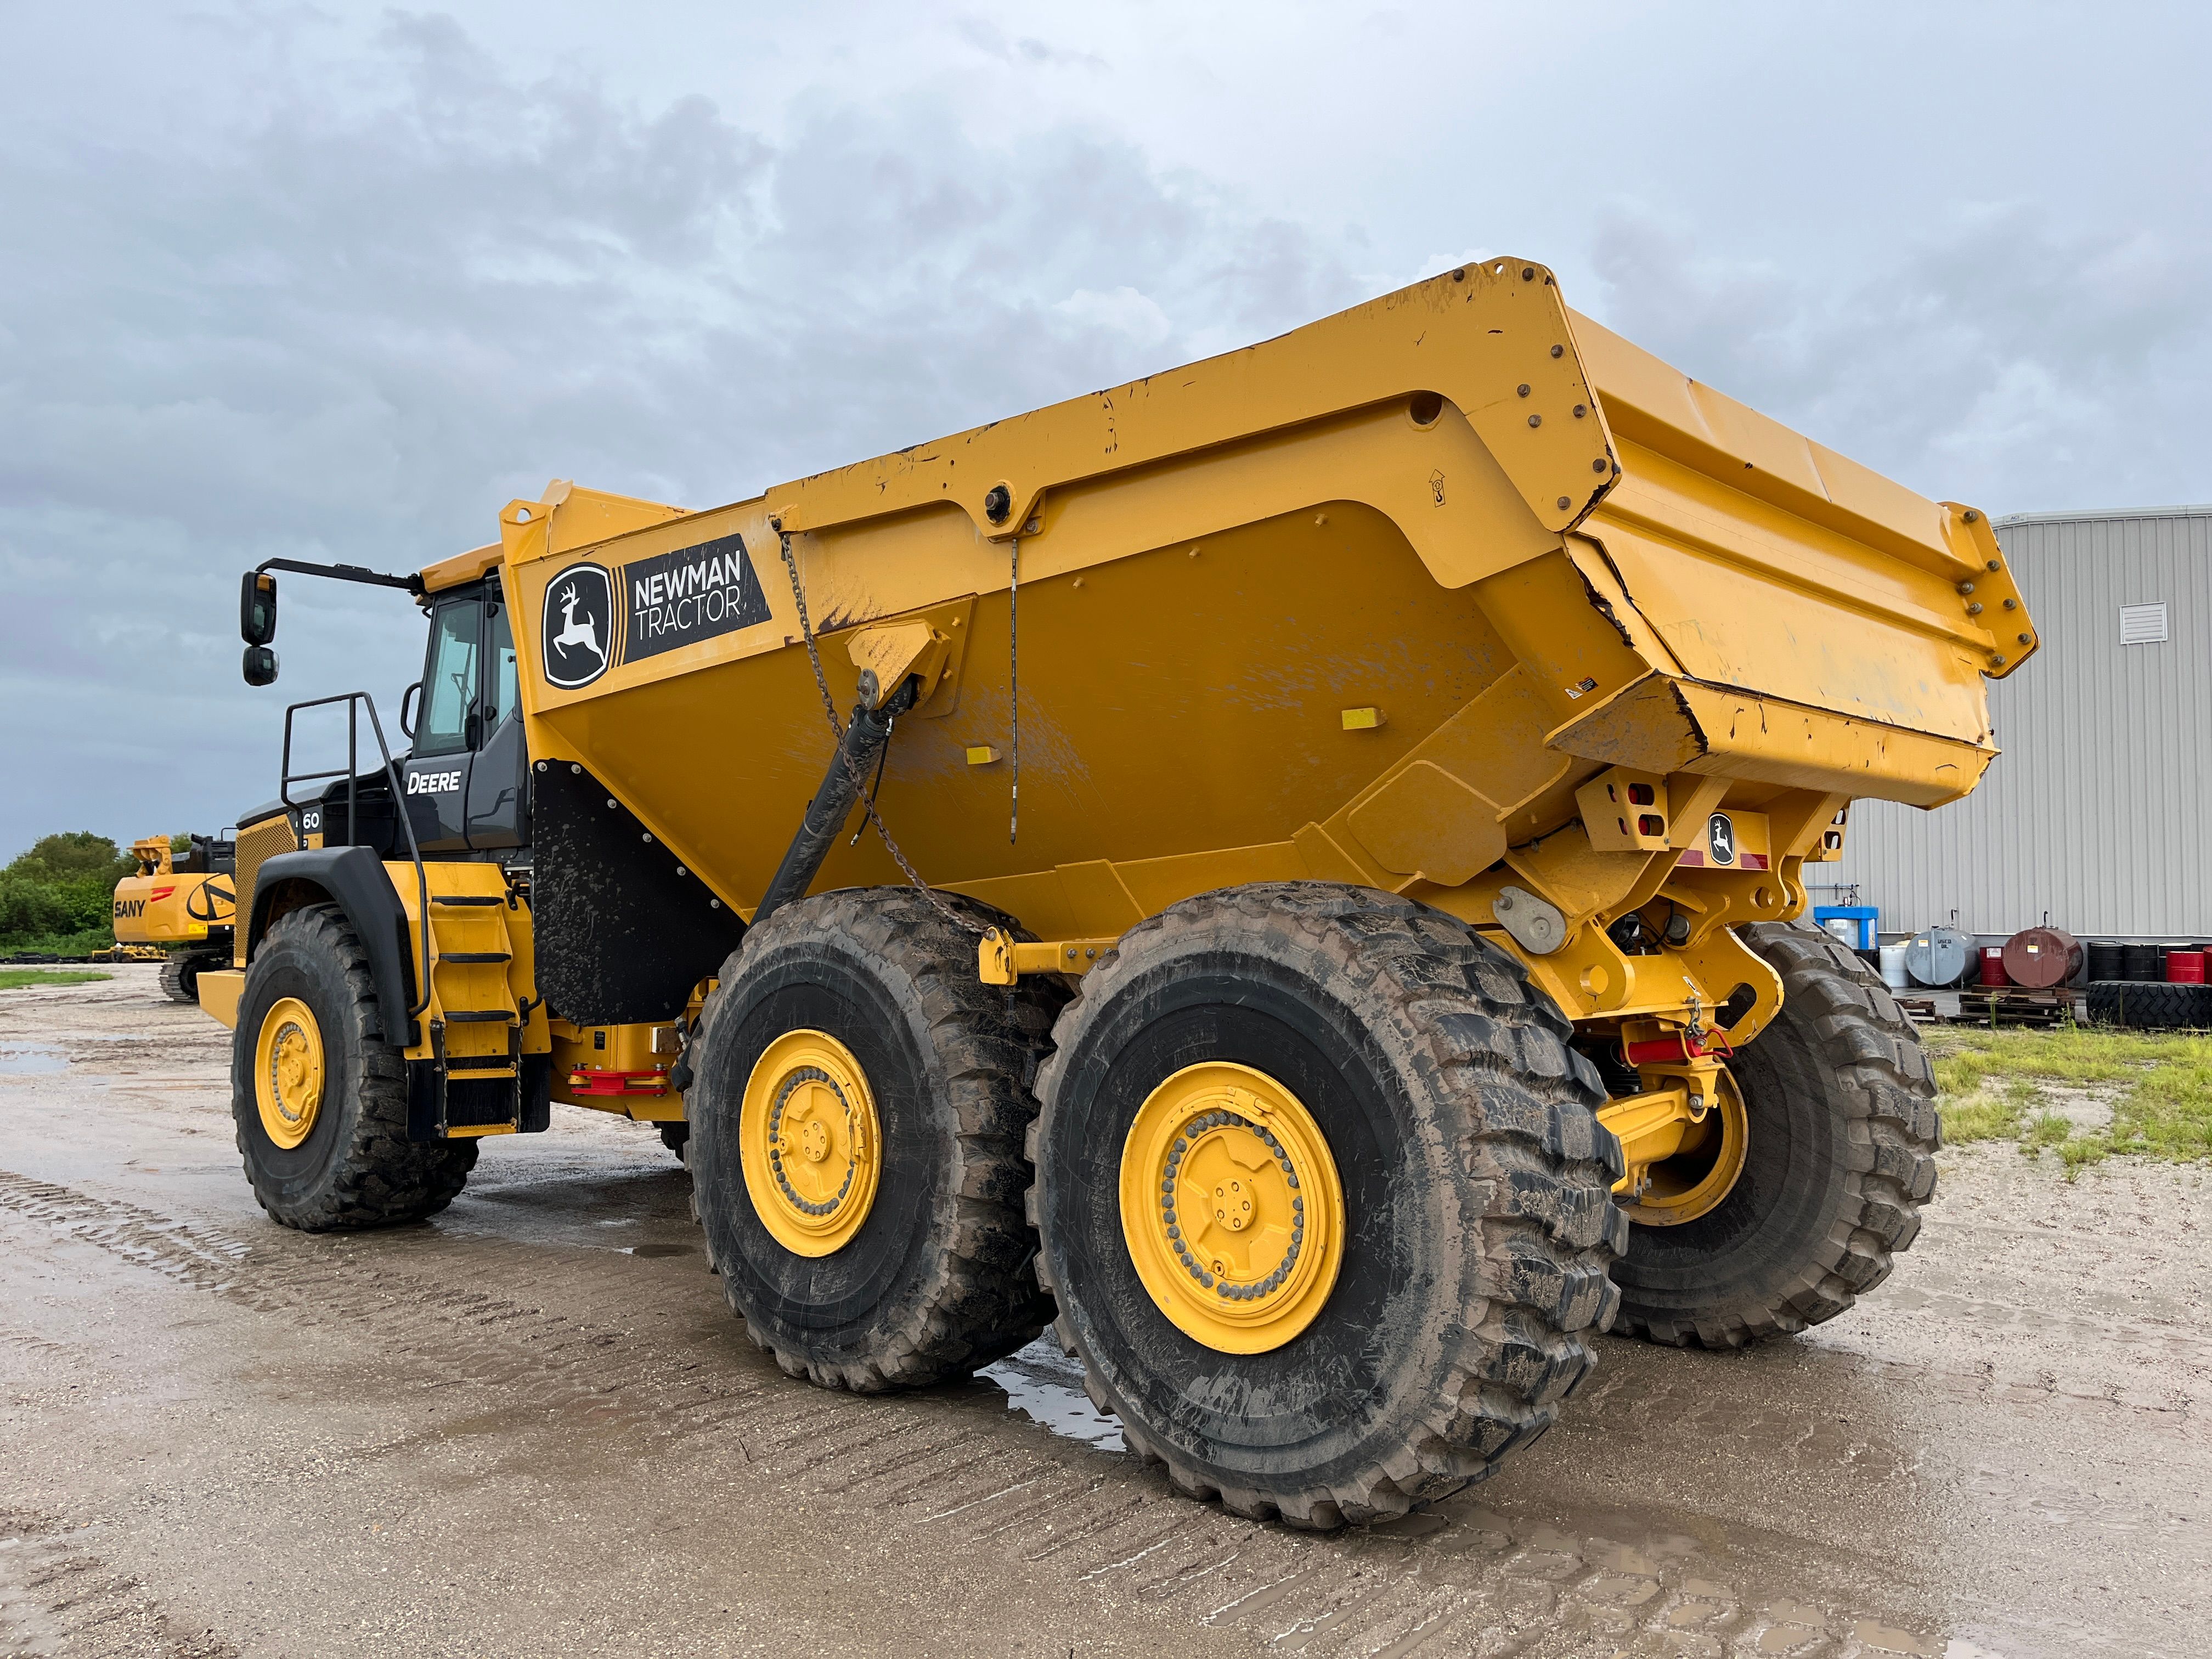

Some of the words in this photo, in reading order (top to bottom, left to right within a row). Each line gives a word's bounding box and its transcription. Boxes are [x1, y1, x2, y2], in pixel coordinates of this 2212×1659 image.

[636, 550, 740, 610] NEWMAN
[635, 585, 740, 640] TRACTOR
[407, 771, 461, 794] DEERE
[115, 900, 146, 918] SANY
